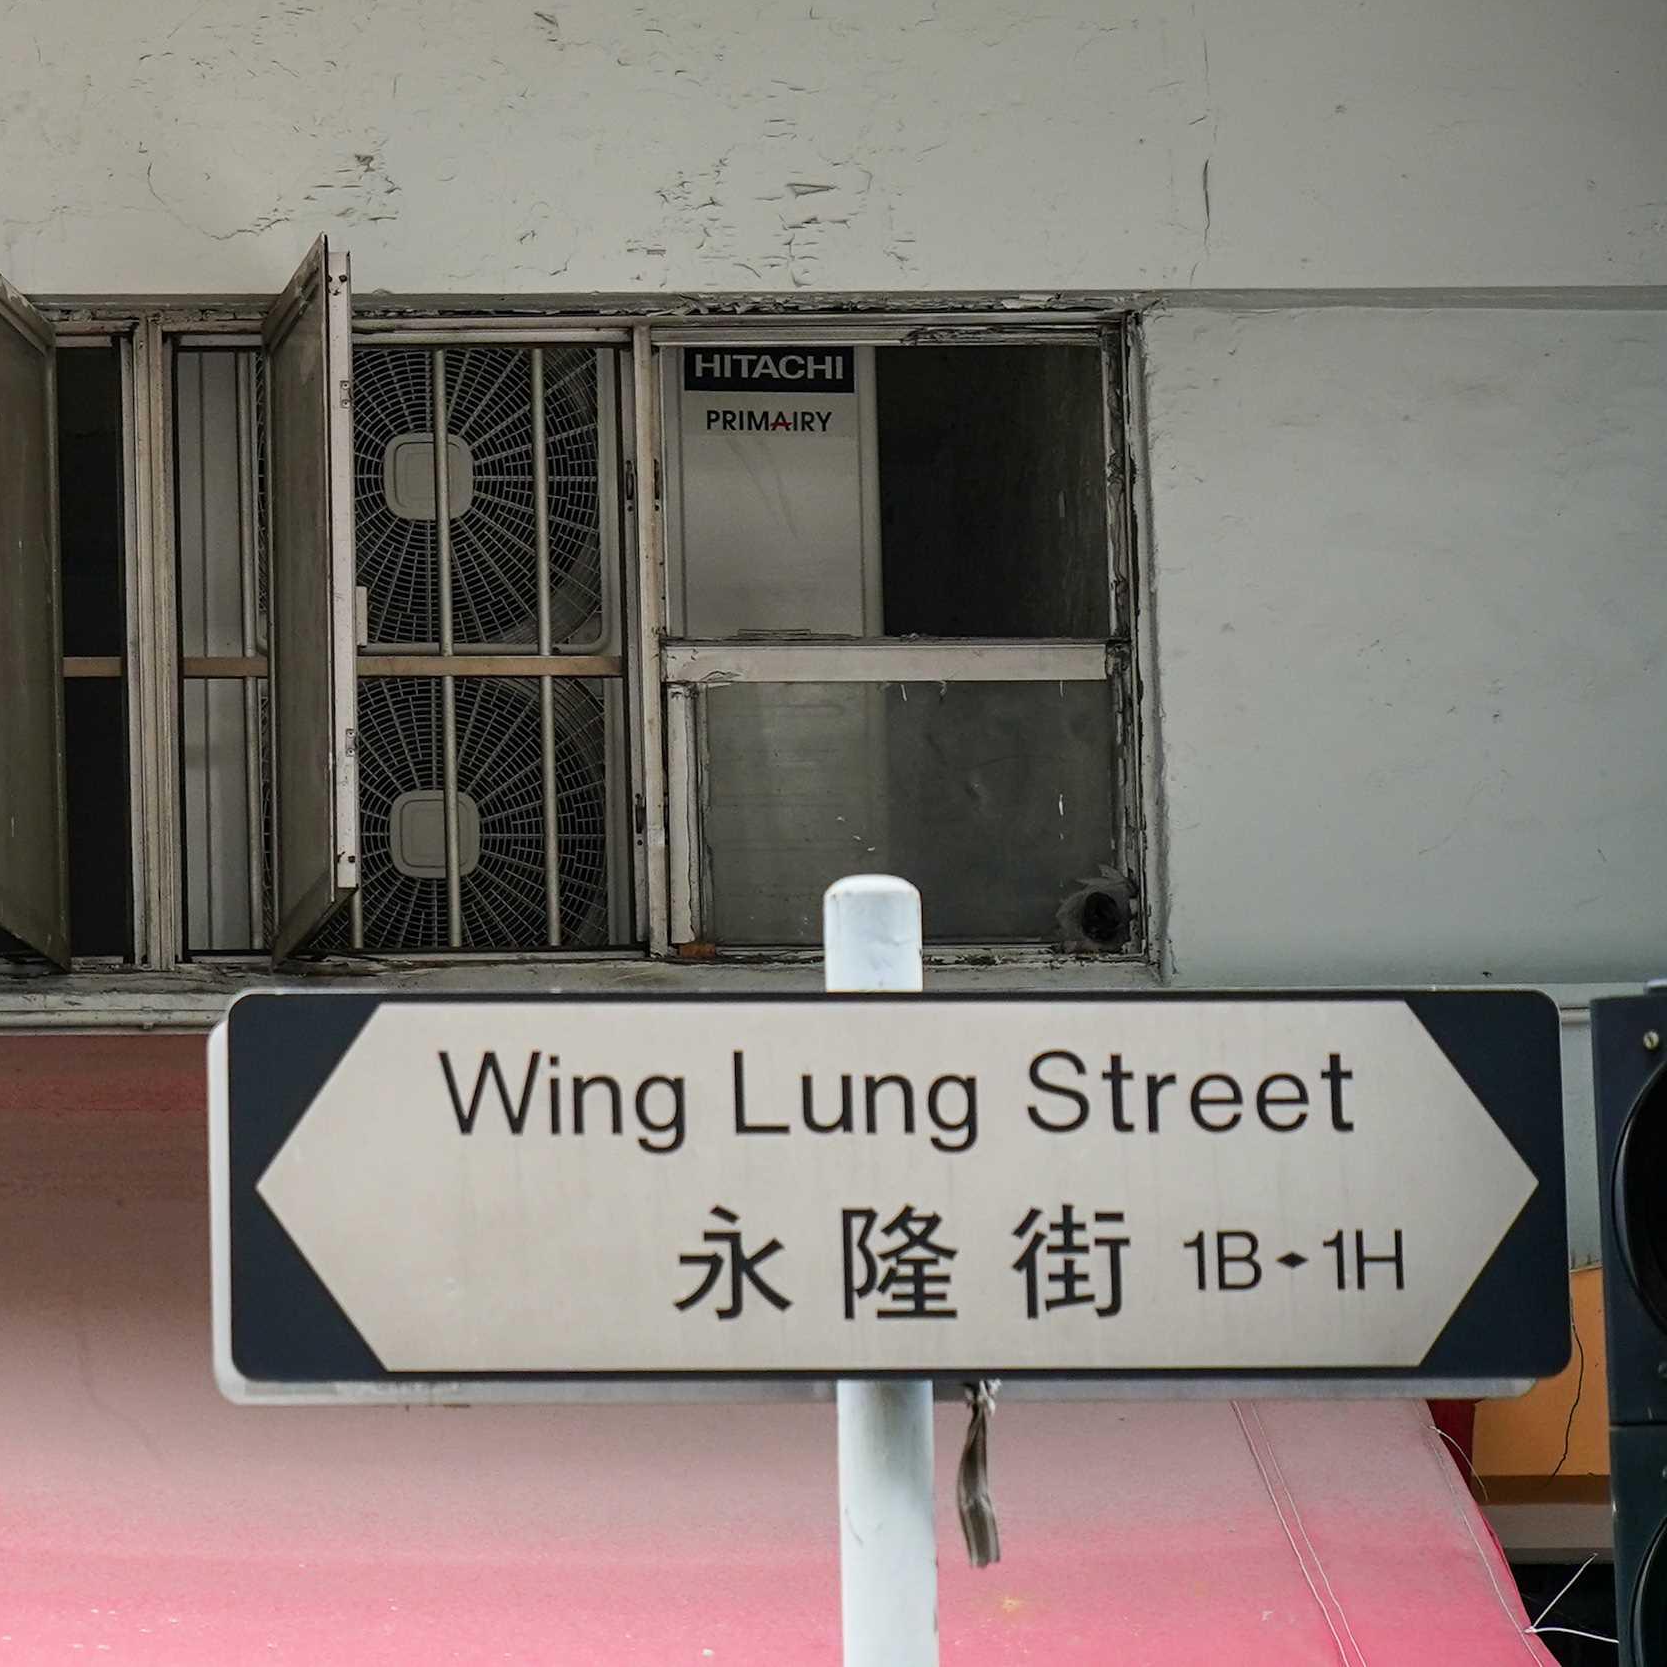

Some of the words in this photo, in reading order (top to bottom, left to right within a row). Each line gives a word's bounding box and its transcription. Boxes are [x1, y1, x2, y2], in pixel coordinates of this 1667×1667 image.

[695, 354, 843, 379] HITACHI
[707, 410, 833, 432] PRIMAIRY
[439, 1050, 686, 1153] Wing
[732, 1050, 979, 1153] Lung
[1027, 1050, 1354, 1137] Street
[674, 1204, 1130, 1321] 永隆街
